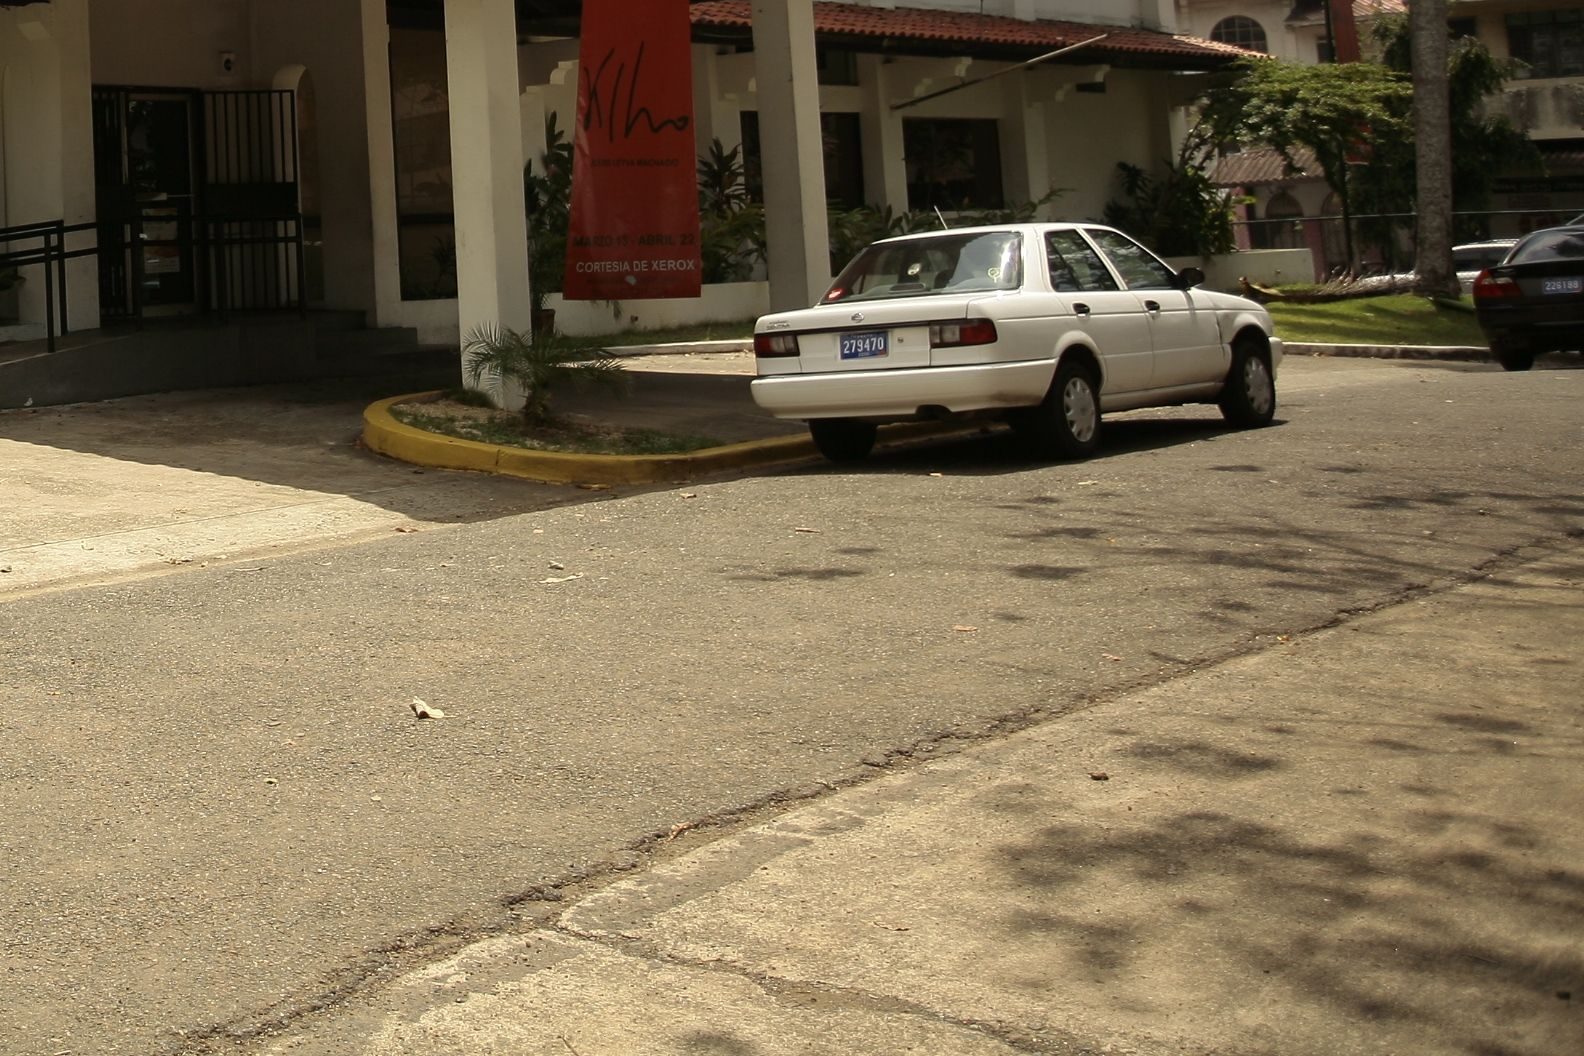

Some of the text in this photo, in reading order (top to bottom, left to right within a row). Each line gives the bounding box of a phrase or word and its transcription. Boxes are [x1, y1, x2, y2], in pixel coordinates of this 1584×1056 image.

[639, 233, 675, 246] ABRIL
[680, 233, 695, 246] 22
[576, 259, 695, 272] CORTESIA DE XEROX
[843, 336, 884, 354] 279470
